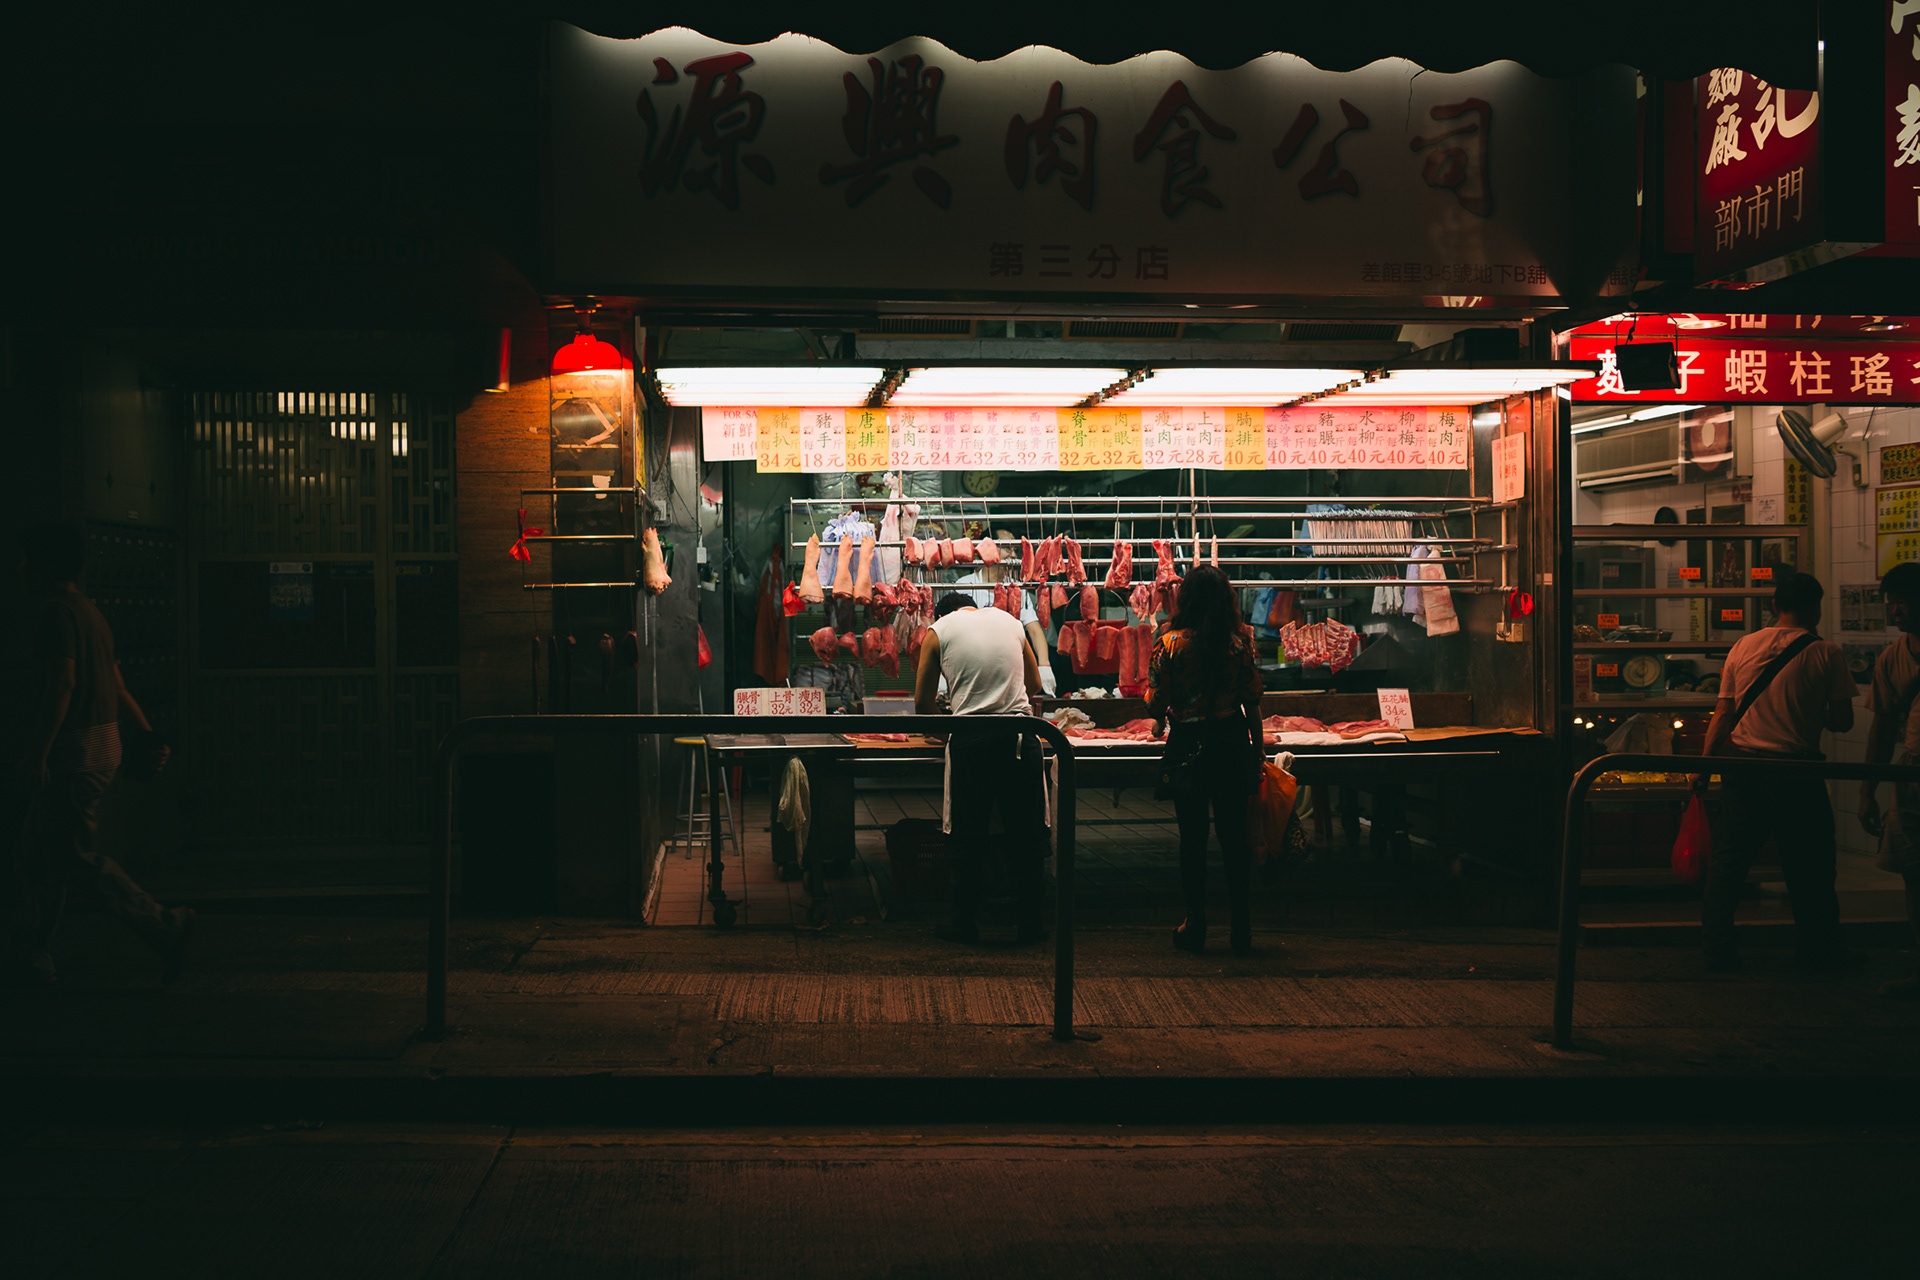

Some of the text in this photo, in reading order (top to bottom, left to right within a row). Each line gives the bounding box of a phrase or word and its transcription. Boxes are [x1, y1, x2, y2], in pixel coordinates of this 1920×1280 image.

[636, 51, 1495, 215] 源興肉食公司
[988, 241, 1169, 281] 第三分店
[723, 411, 741, 420] FOR
[816, 412, 833, 448] 豬手
[858, 411, 875, 447] 唐排
[1198, 411, 1213, 445] 上肉
[1439, 411, 1456, 445] 梅肉
[760, 453, 801, 467] 34元
[805, 453, 844, 467] 18元
[847, 452, 888, 467] 36元
[891, 452, 929, 466] 32元
[930, 451, 972, 466] 24元
[974, 451, 1014, 466] 32元
[1018, 451, 1057, 465] 32元
[1060, 451, 1100, 466] 32元
[1103, 450, 1142, 465] 32元
[1145, 450, 1184, 464] 32元
[1186, 450, 1223, 464] 28元
[1224, 450, 1264, 464] 40元
[1267, 450, 1306, 464] 40元
[1308, 450, 1346, 464] 40元
[1348, 449, 1385, 464] 40元
[1387, 450, 1425, 464] 40元
[1428, 450, 1465, 464] 40元
[770, 690, 794, 704] 上骨
[798, 690, 821, 703] 瘦肉
[737, 704, 759, 715] 24元
[771, 703, 793, 715] 32元
[800, 701, 821, 715] 32元
[1385, 705, 1407, 716] 34元
